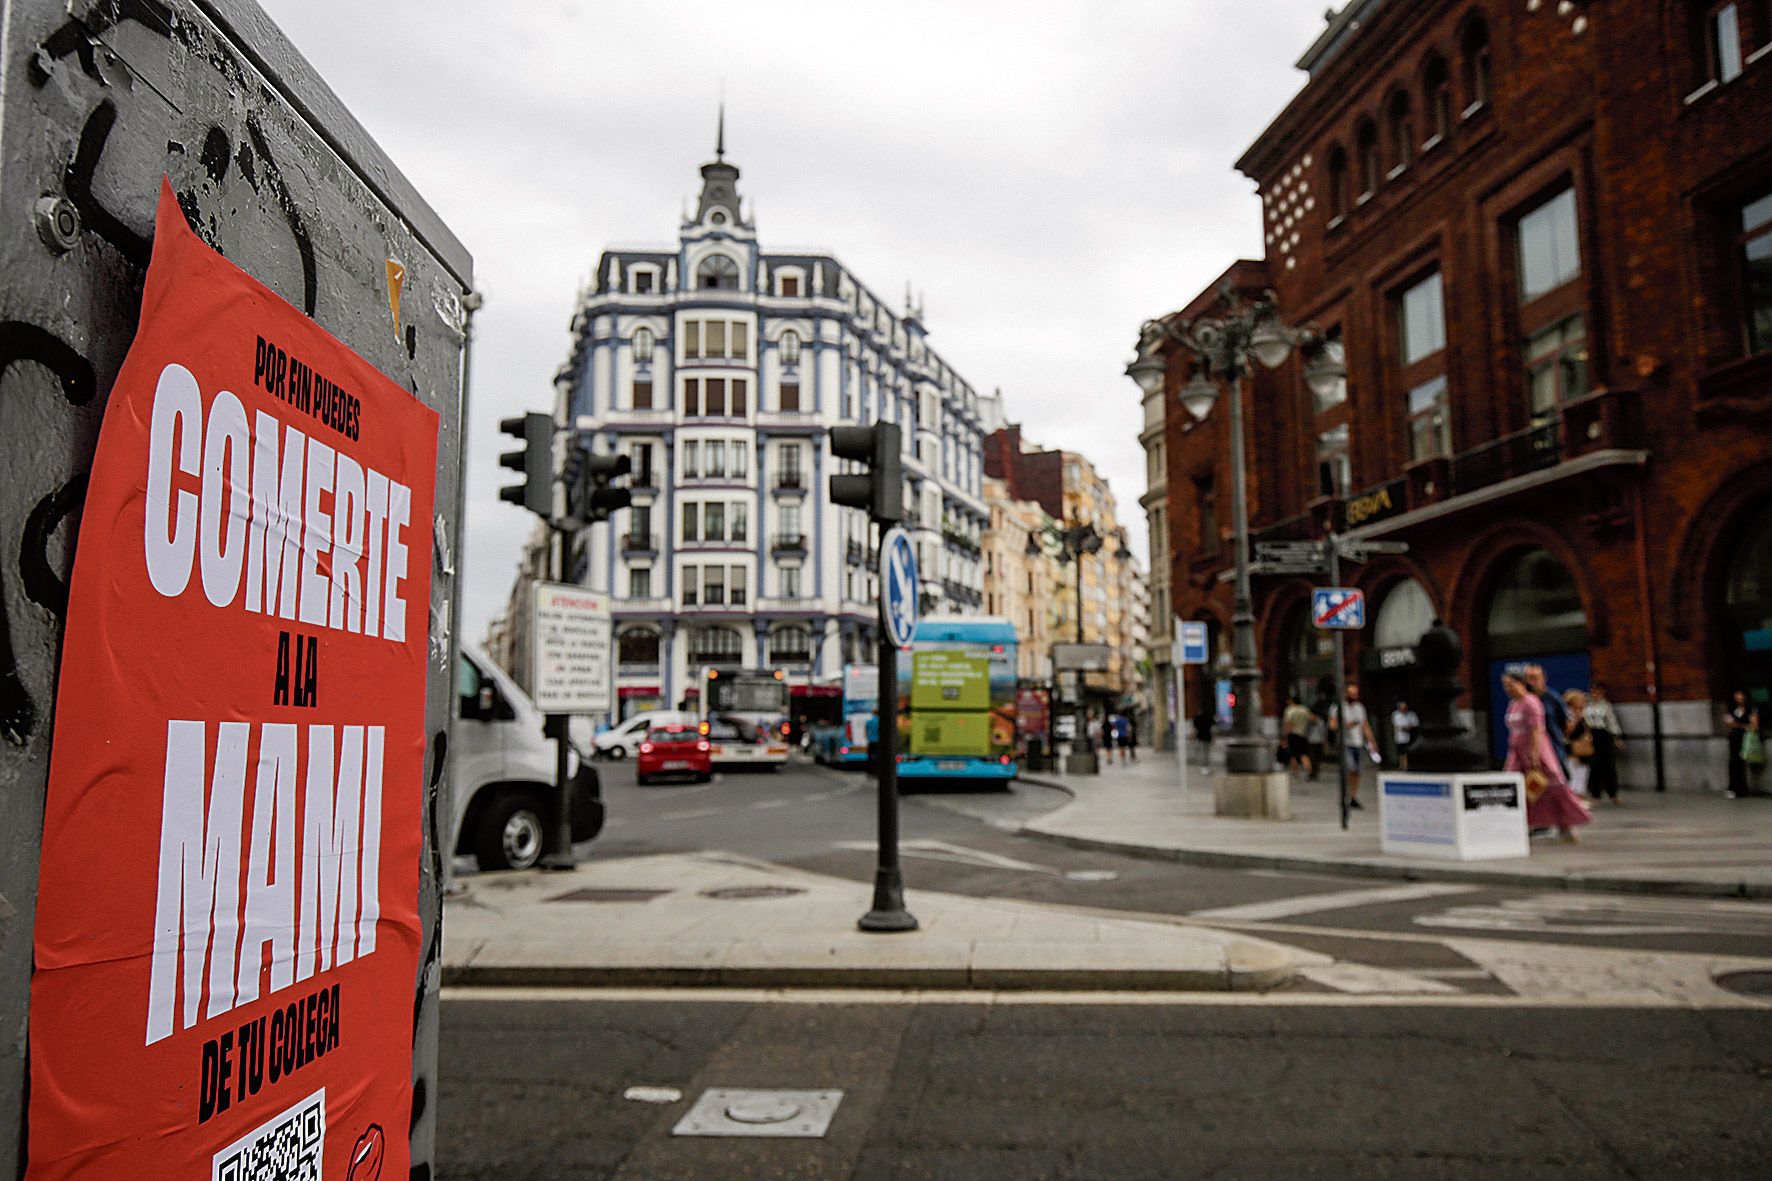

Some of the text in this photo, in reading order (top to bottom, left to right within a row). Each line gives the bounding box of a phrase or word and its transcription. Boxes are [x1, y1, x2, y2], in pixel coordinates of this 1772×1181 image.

[254, 335, 361, 441] POR FIN PUEDES
[144, 363, 411, 643] COMERTE
[273, 631, 317, 708] A LA
[145, 720, 385, 1046] MAMI
[199, 983, 340, 1125] DE TU COLEGA
